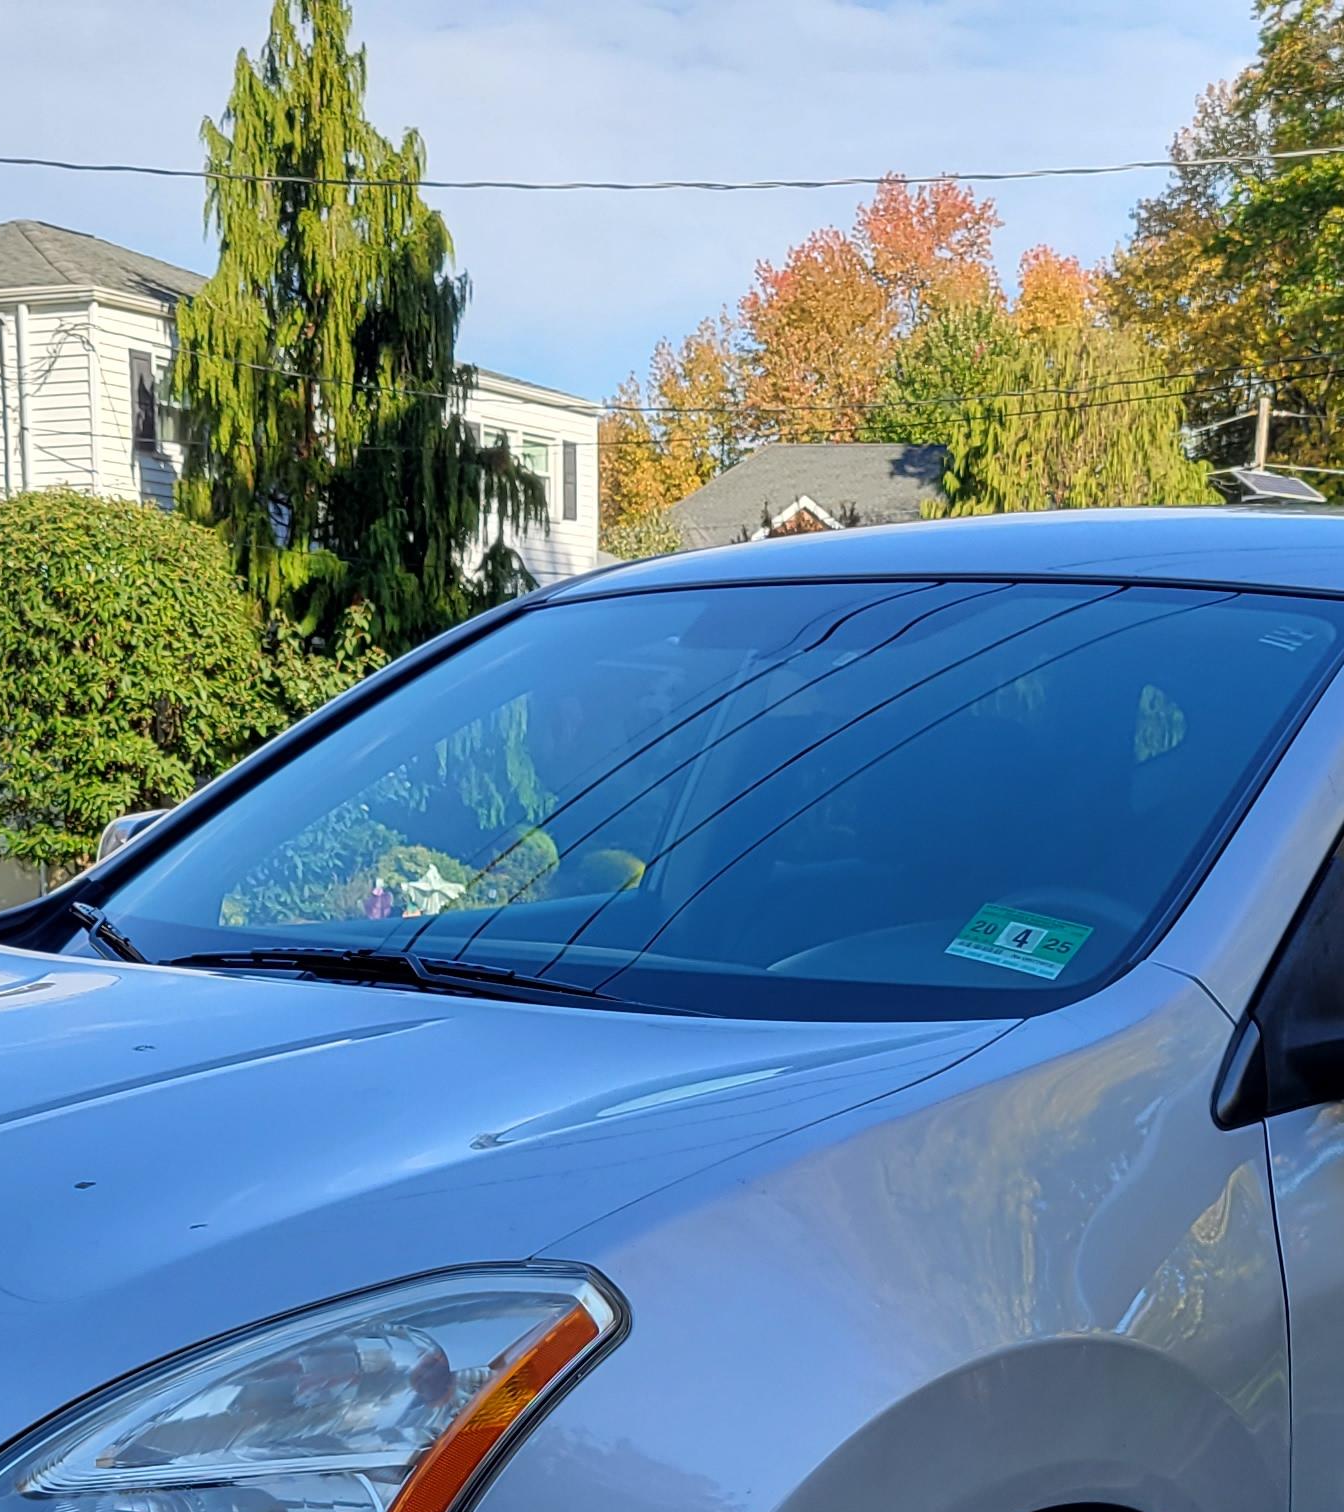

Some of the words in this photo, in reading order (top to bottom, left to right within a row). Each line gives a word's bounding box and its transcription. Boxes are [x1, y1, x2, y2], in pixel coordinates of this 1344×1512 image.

[971, 920, 998, 935] 20
[1012, 928, 1033, 948] 4
[1044, 938, 1073, 954] 25
